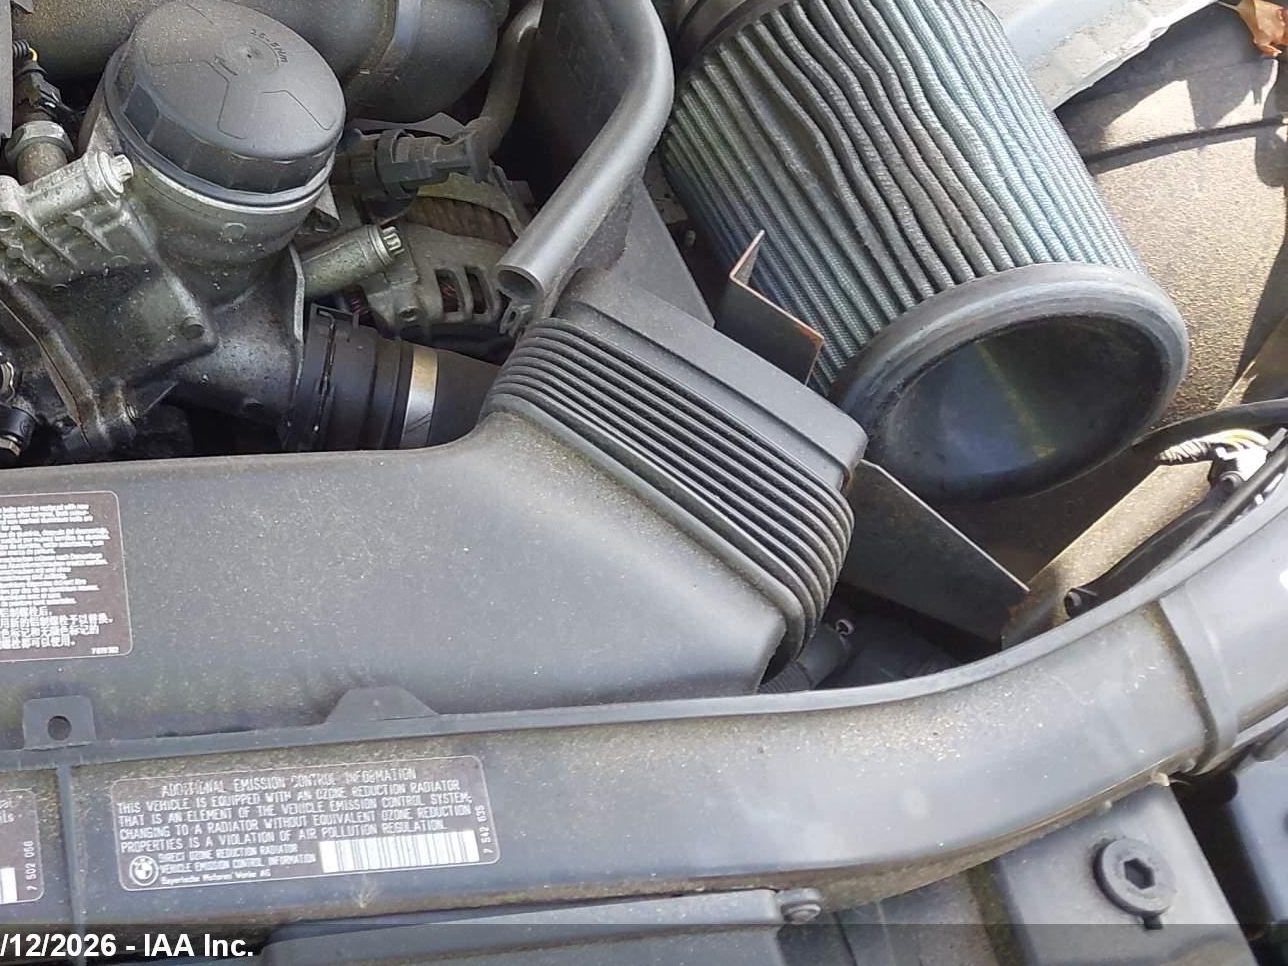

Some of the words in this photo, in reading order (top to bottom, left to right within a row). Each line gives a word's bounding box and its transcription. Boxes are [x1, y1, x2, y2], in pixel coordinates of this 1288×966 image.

[233, 775, 285, 792] EMISSION
[290, 772, 336, 787] CONTROL
[344, 766, 416, 784] INFORMATION
[117, 801, 140, 814] THIS
[145, 798, 190, 812] VEHICLE
[195, 796, 206, 808] IS
[211, 793, 260, 807] EQUIPPED
[264, 790, 291, 803] WITH
[296, 789, 312, 801] AN
[316, 786, 346, 799] OZONE
[351, 782, 406, 797] REDUCTION
[409, 778, 460, 792] RADIATOR
[118, 814, 144, 827] THAT
[151, 812, 162, 824] IS
[167, 811, 182, 823] AN
[187, 807, 232, 822] ELEMENT
[237, 806, 251, 818] OF
[255, 804, 276, 816] THE
[280, 800, 325, 815] VEHICLE
[329, 797, 377, 811] EMISSION
[380, 793, 425, 807] CONTROL
[119, 825, 170, 840] CHANGING
[174, 824, 188, 836] TO
[193, 823, 202, 834] A
[206, 819, 258, 833] RADIATOR
[263, 815, 306, 829] WITHOUT
[312, 810, 375, 825] EQUIVALENT
[381, 807, 413, 820] OZONE
[416, 803, 471, 818] REDUCTION
[120, 837, 183, 853] PROPERTIES
[188, 836, 200, 848] IS
[204, 835, 213, 847] A
[217, 830, 274, 846] VIOLATION
[278, 829, 292, 841] OF
[297, 827, 317, 840] AIR
[321, 823, 377, 838] POLLUTION
[158, 851, 184, 863] DIRECT
[189, 849, 213, 860] OZONE
[215, 846, 257, 858] REDUCTION
[260, 843, 297, 855] RADIATOR
[160, 862, 192, 874] VEHICLE
[194, 859, 230, 871] EMISSION
[231, 857, 264, 868] CONTROL
[267, 853, 316, 865] INFORMATION
